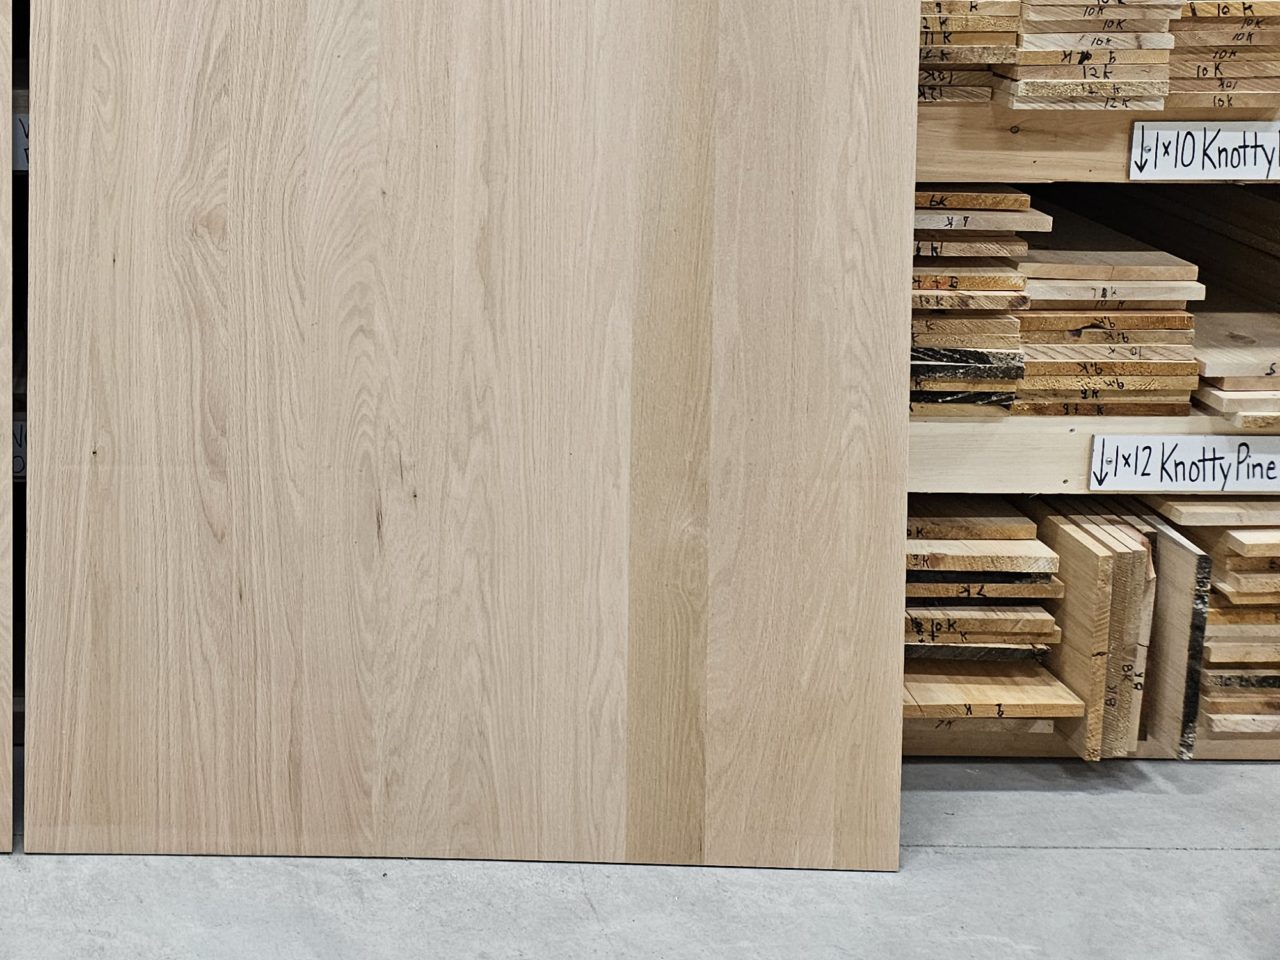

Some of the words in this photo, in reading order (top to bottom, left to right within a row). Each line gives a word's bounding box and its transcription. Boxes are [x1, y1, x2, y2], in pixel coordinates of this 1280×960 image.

[1154, 130, 1196, 170] 1x10
[1201, 126, 1276, 179] Knotty
[1113, 444, 1153, 477] 1x12
[1160, 441, 1232, 492] Knotty
[1236, 442, 1279, 481] Pine
